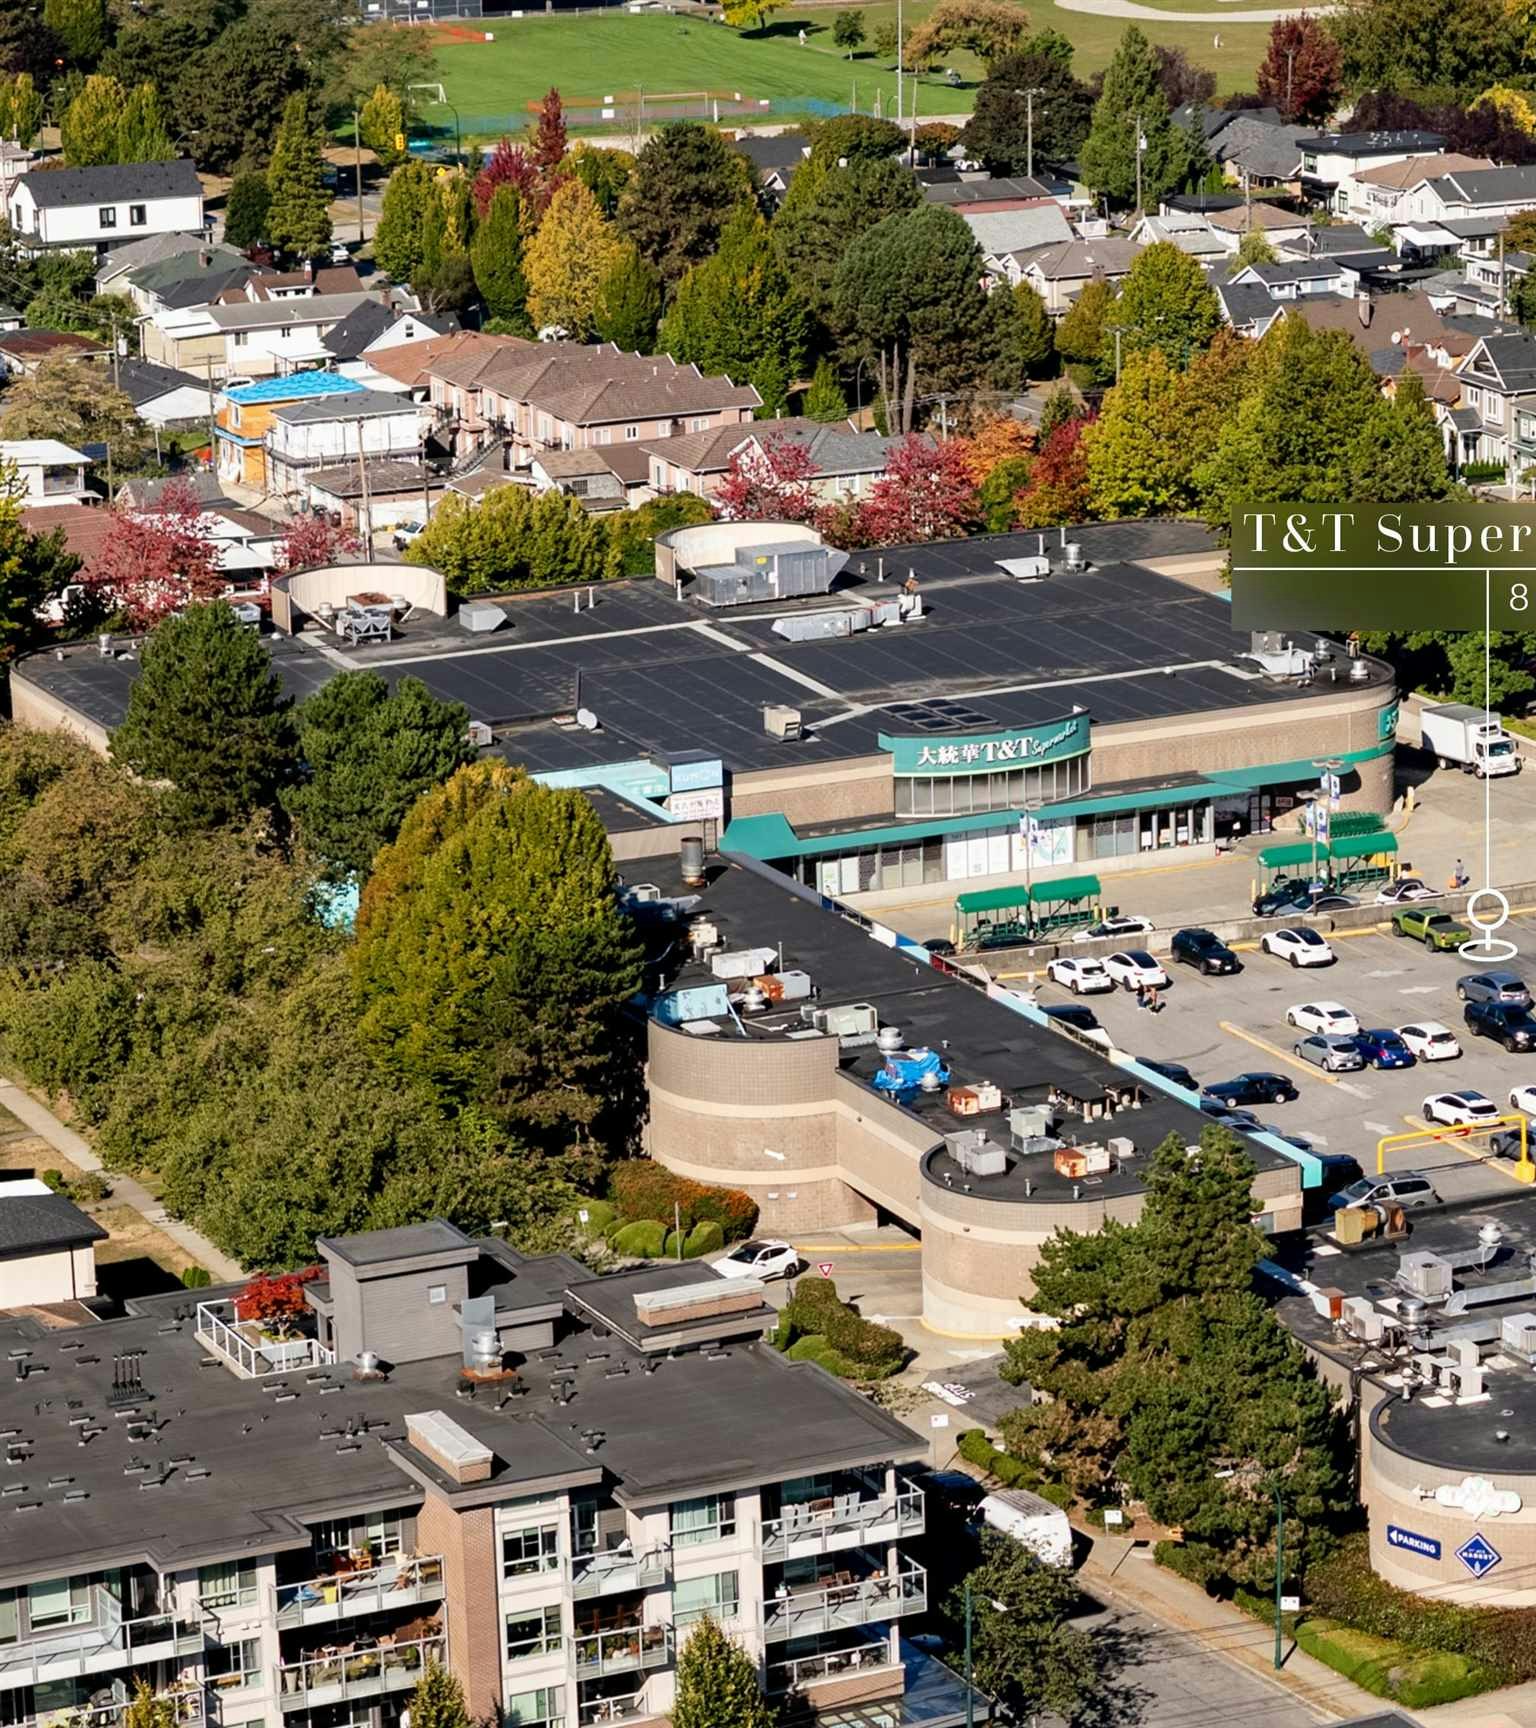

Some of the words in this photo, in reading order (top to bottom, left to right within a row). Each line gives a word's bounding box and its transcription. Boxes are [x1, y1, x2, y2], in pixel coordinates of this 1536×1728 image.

[917, 743, 981, 767] 大統華
[980, 736, 1034, 763] T&T
[1397, 1533, 1437, 1555] PARKING
